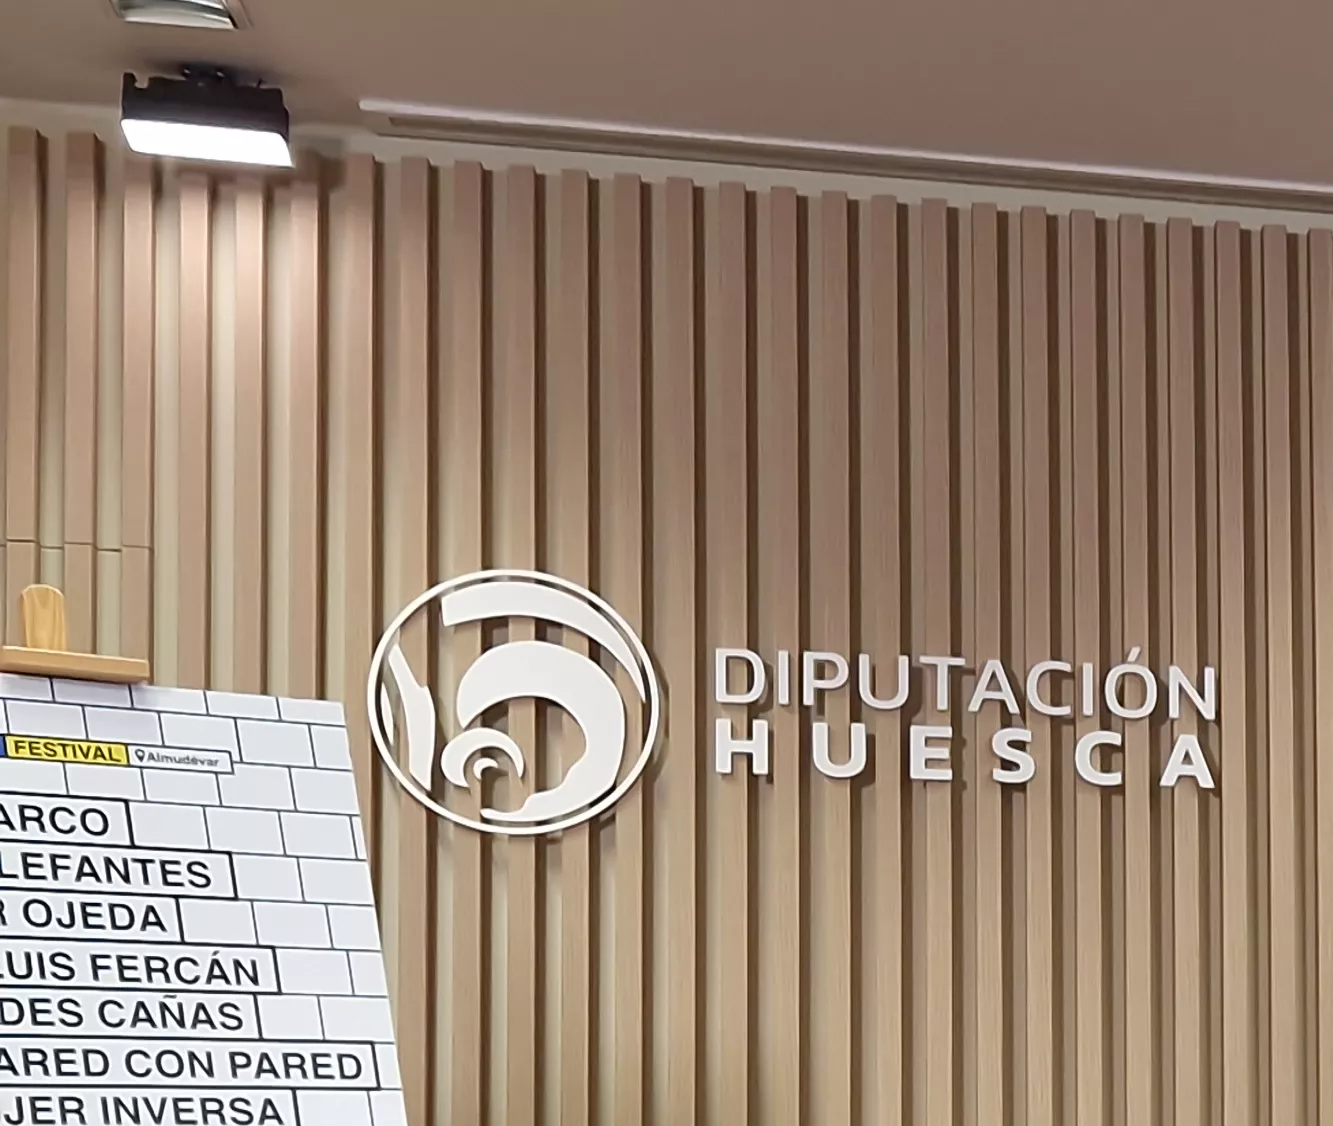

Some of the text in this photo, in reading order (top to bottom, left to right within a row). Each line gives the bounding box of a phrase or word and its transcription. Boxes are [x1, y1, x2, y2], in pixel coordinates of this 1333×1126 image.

[714, 646, 1217, 721] DIPUTACIÓN
[13, 739, 122, 762] FESTIVAL
[714, 717, 1217, 790] HUESCA
[22, 898, 167, 932] OJEDA
[0, 950, 260, 986] UIS FERCÁN
[98, 995, 243, 1030] CAÑAS
[124, 1049, 215, 1079] CON
[229, 1051, 362, 1080] PARED
[100, 1096, 284, 1126] INVERSA
